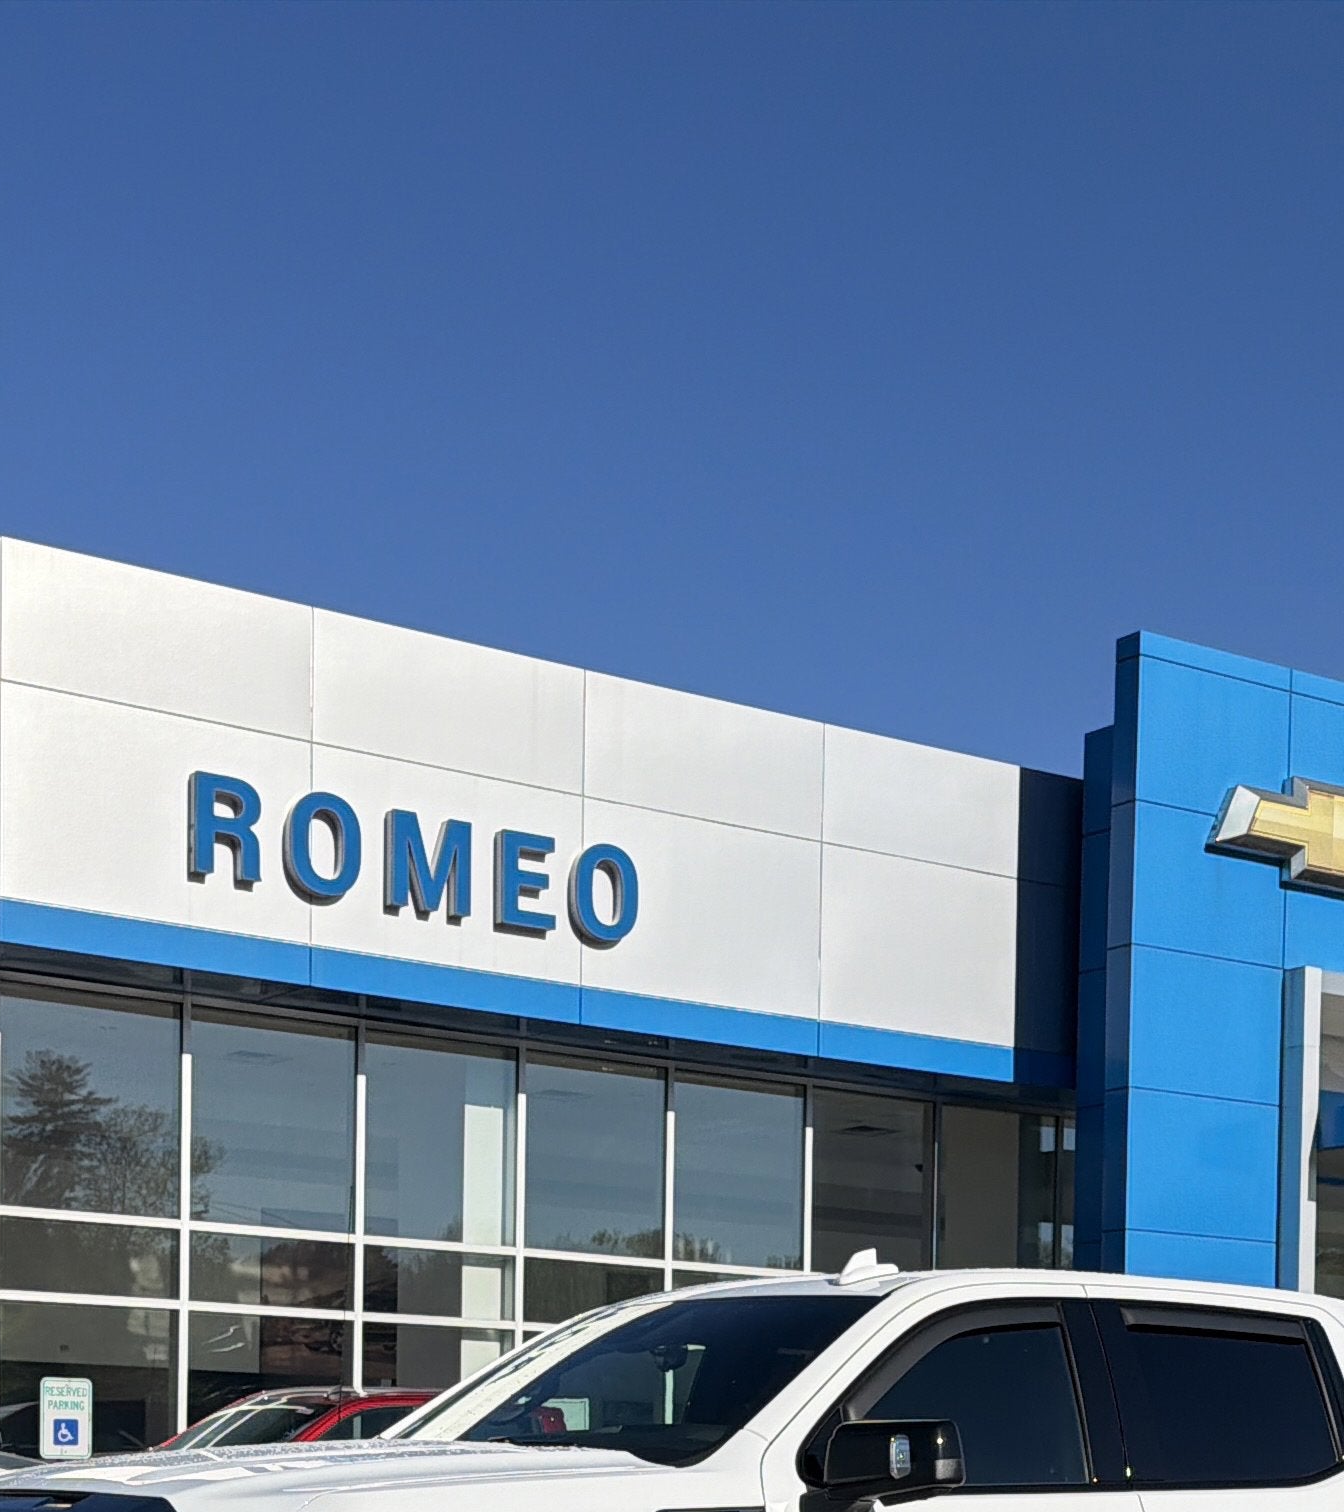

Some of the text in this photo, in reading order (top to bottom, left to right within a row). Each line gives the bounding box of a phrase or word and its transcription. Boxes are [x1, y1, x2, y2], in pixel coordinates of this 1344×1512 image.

[188, 770, 640, 951] ROMEO
[45, 1386, 87, 1397] RESERVED
[47, 1400, 84, 1411] PARKING
